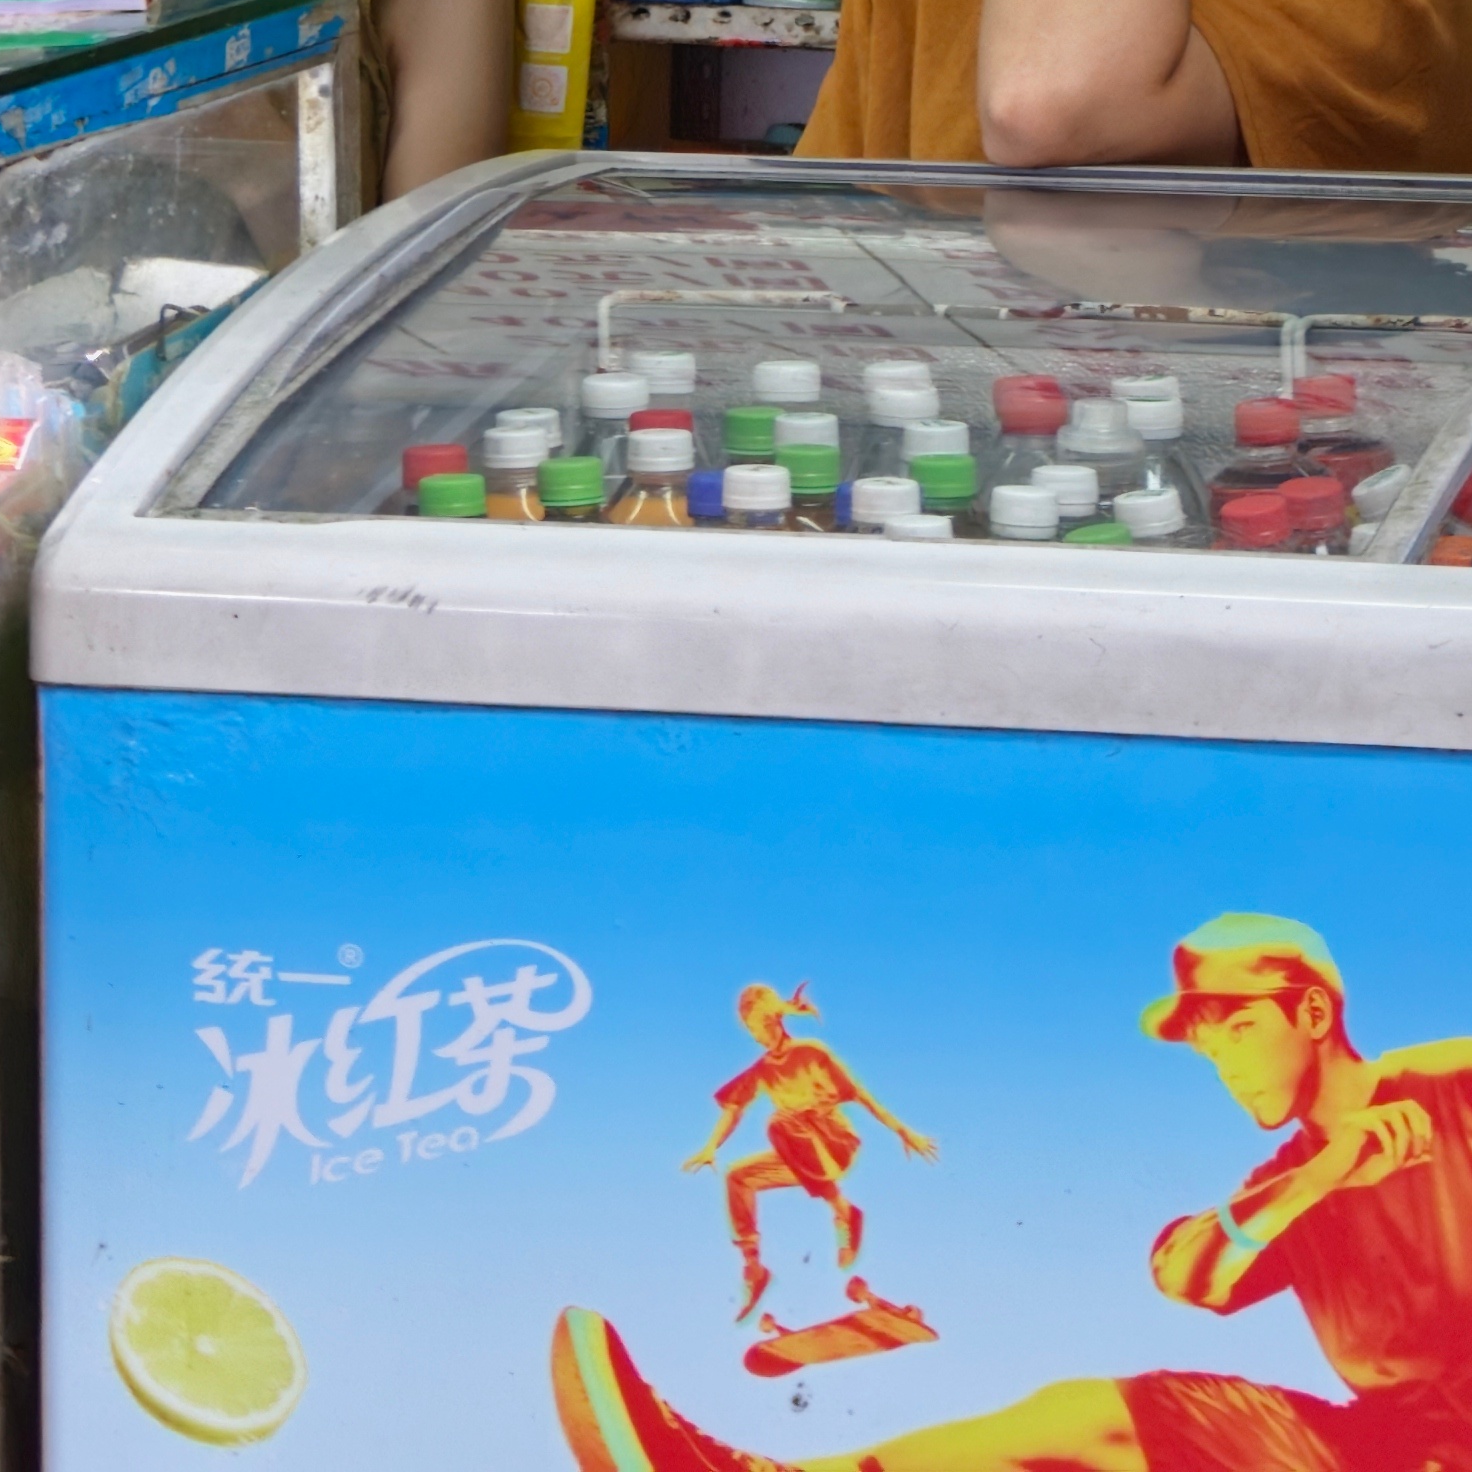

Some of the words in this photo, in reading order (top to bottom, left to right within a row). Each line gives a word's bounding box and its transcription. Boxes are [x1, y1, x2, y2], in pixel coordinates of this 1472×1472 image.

[191, 947, 352, 1007] 统一
[185, 938, 593, 1191] 冰红茶
[309, 1145, 385, 1185] Ice
[396, 1125, 481, 1164] Tea
